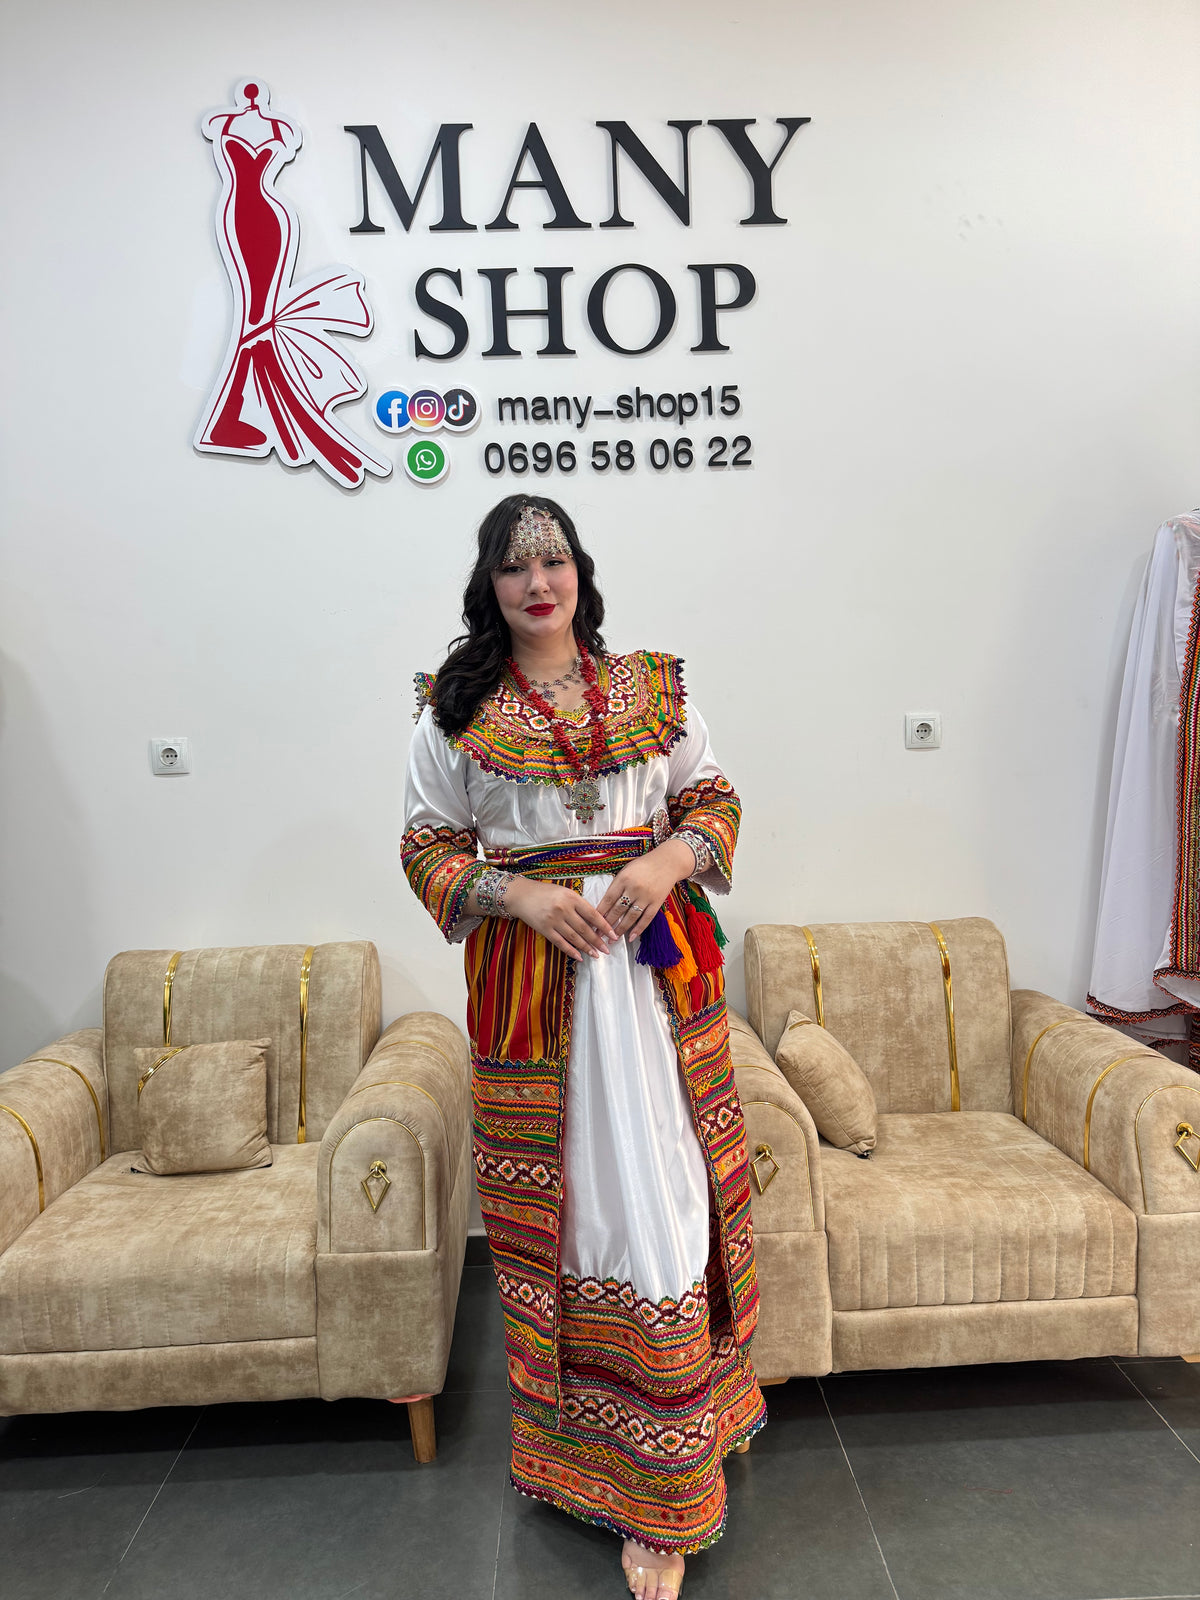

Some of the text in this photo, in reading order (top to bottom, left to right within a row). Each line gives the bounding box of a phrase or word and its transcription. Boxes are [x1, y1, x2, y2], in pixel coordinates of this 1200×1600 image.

[344, 117, 811, 233] MANY
[414, 263, 756, 360] SHOP
[498, 385, 741, 428] many_shop15
[484, 435, 752, 474] 0696 58 06 22
